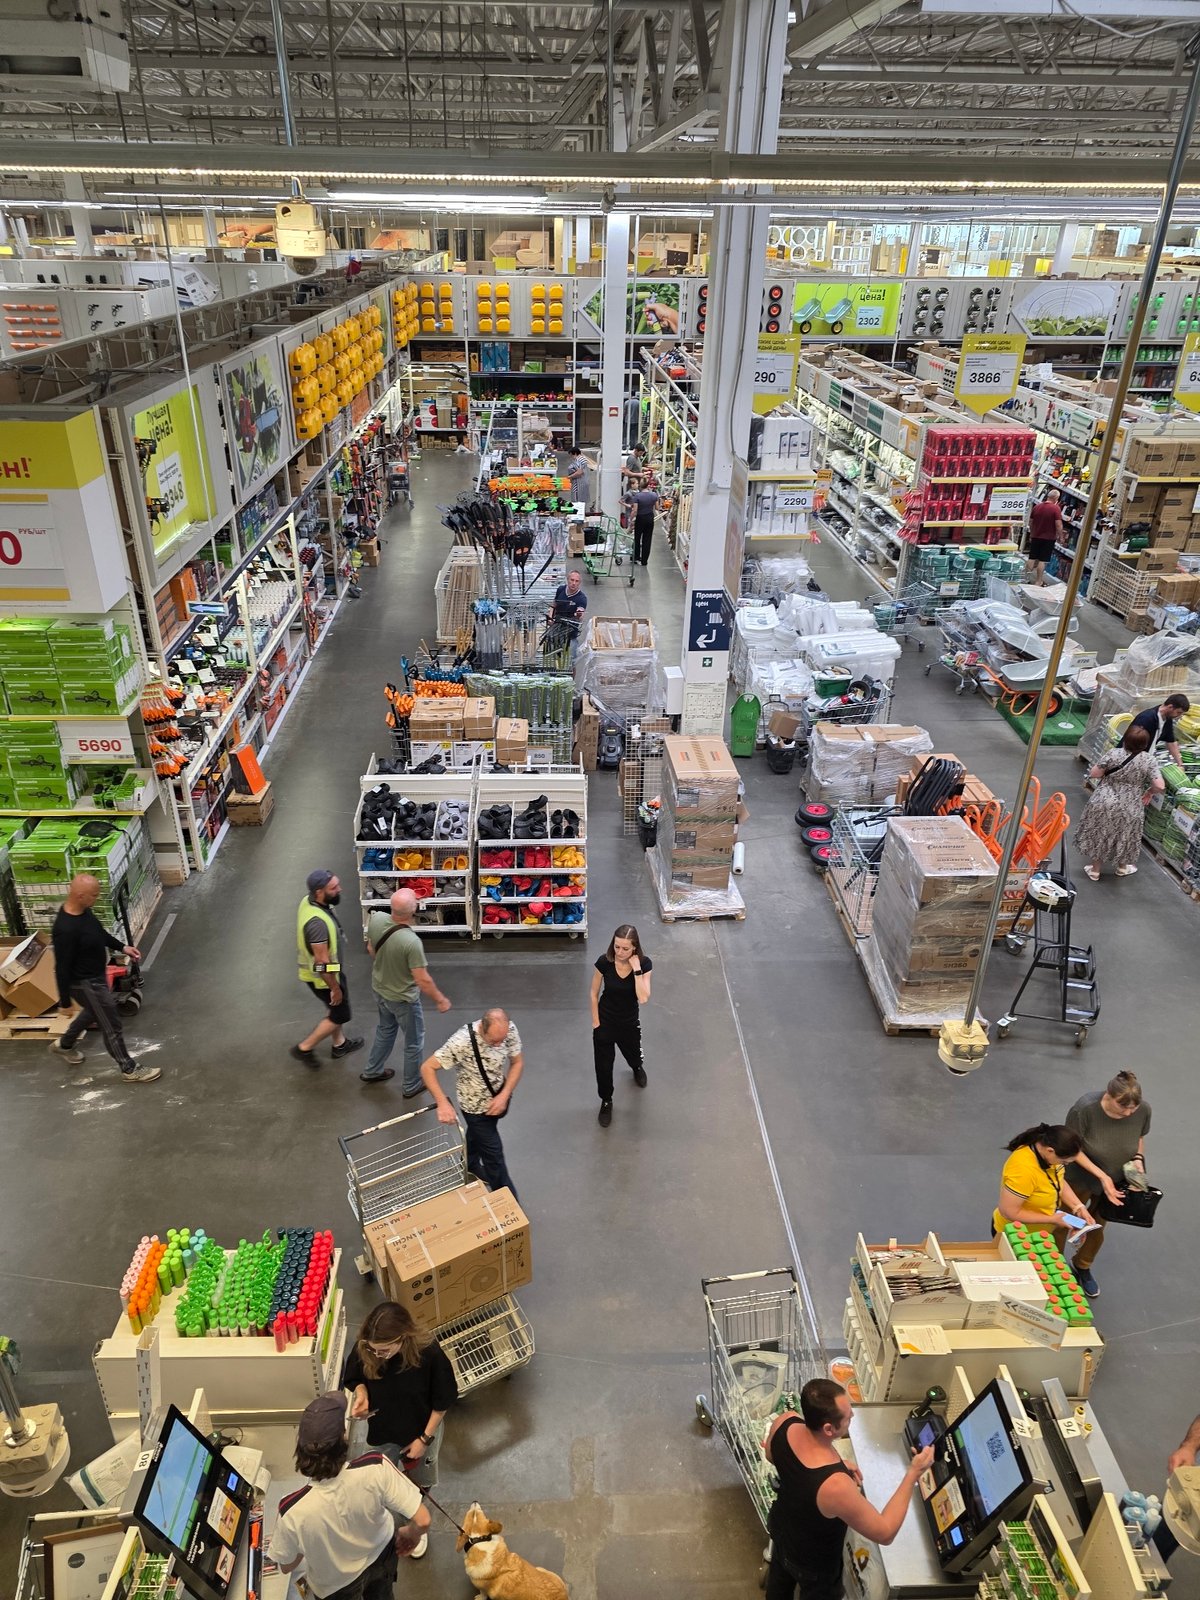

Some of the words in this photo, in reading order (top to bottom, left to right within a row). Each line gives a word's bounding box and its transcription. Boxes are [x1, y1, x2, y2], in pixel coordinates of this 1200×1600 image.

[860, 289, 886, 302] цена!
[858, 317, 880, 326] 2302
[754, 371, 776, 383] 290
[969, 372, 1001, 383] 3866
[1189, 371, 1200, 382] 6
[784, 497, 807, 506] 2290
[1001, 500, 1025, 509] 3866
[78, 739, 122, 752] 5690
[371, 1212, 411, 1232] KOMANCHI
[476, 1217, 519, 1240] KOMANCHI
[392, 1223, 438, 1247] KOMANCHI
[481, 1231, 524, 1255] KOMANCHI
